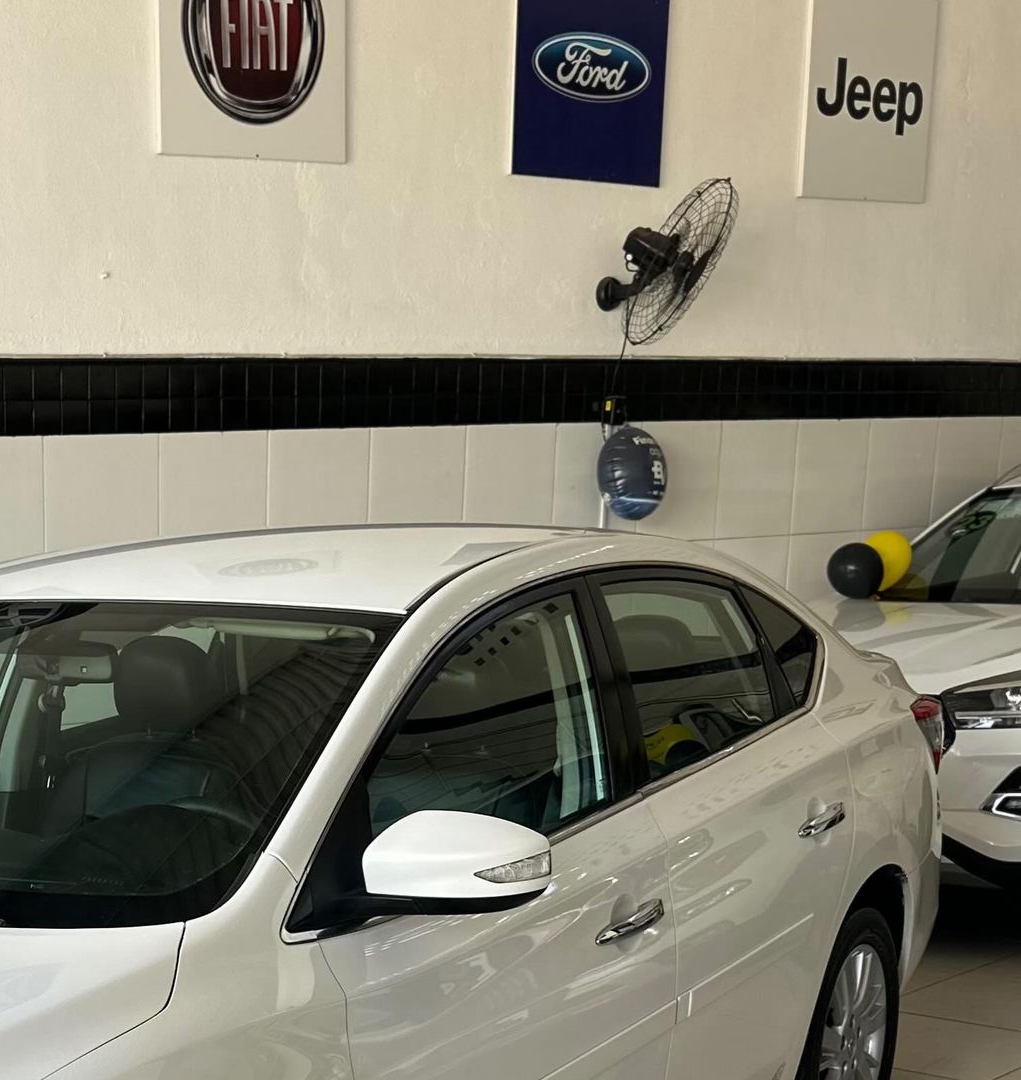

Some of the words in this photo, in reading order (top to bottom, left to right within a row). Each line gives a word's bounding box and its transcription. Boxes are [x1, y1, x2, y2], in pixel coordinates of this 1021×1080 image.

[220, 0, 293, 71] FIAT
[557, 42, 629, 91] Ford
[816, 57, 923, 136] Jeep
